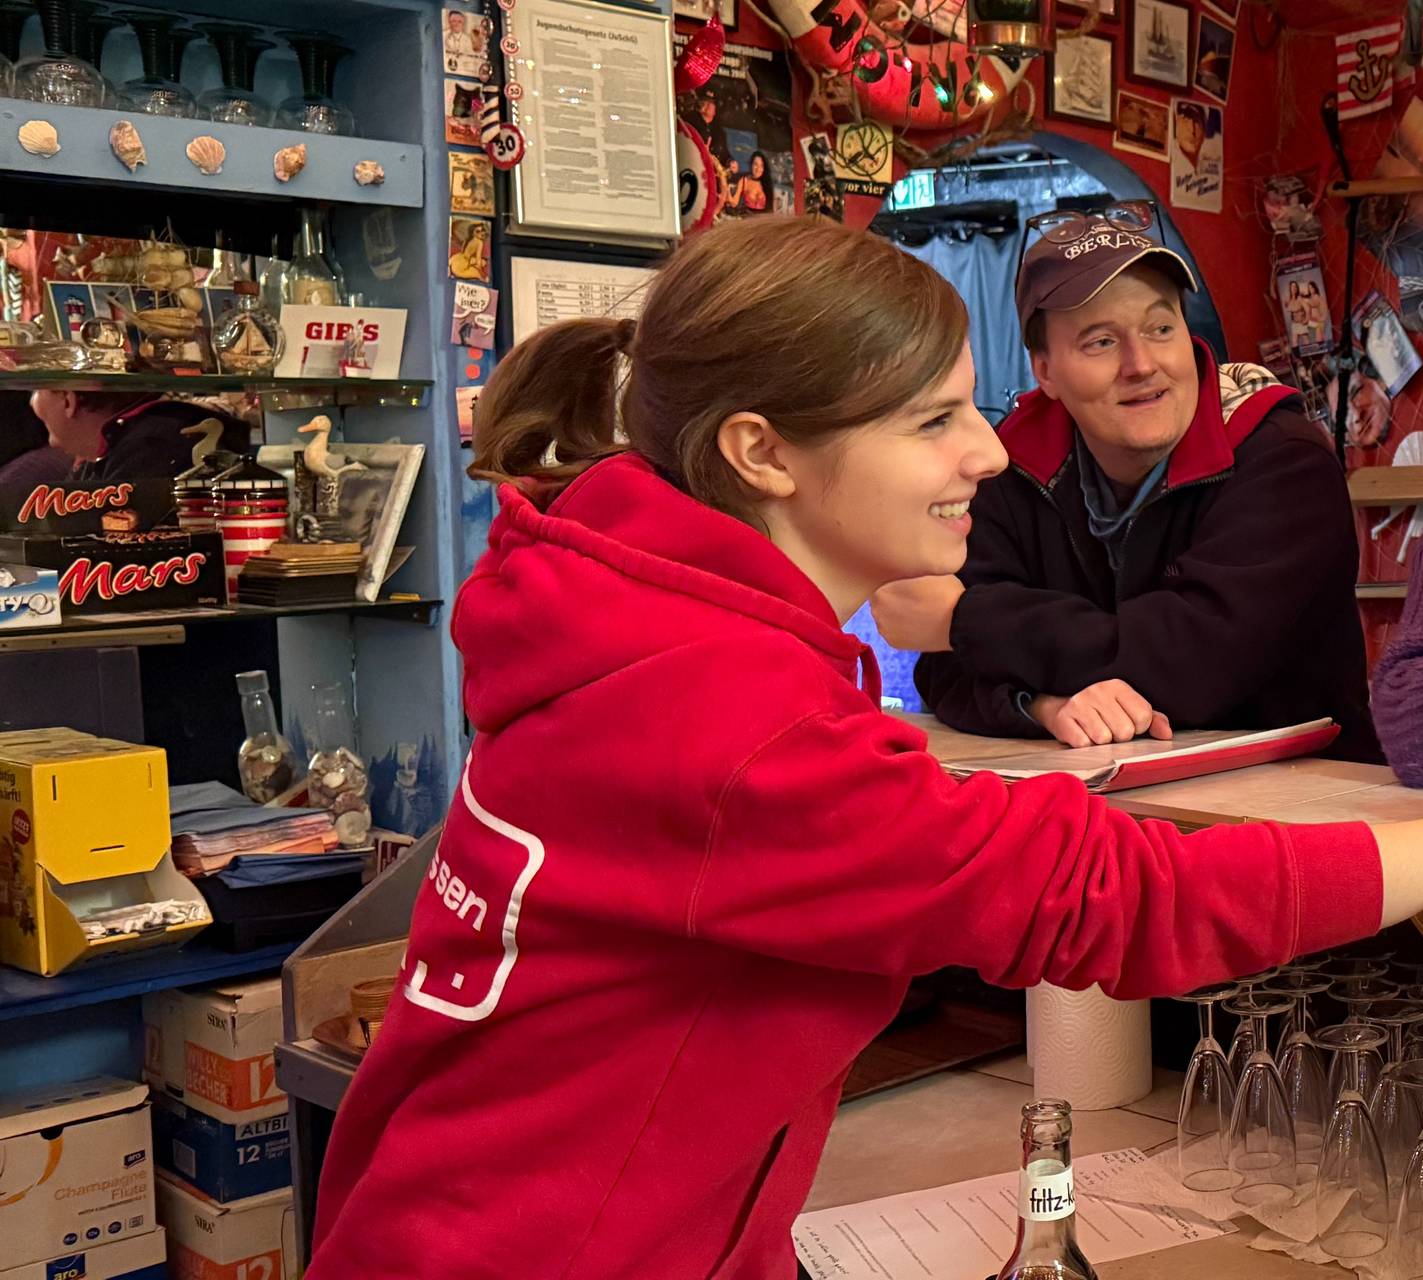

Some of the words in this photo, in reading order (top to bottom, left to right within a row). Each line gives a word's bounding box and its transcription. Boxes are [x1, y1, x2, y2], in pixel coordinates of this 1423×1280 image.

[495, 134, 516, 157] 30
[862, 182, 885, 196] vier
[18, 483, 134, 524] Mars
[59, 553, 206, 605] Mars
[237, 1144, 260, 1165] 12
[54, 1169, 147, 1201] Champagne
[111, 1184, 146, 1201] Flute
[1030, 1182, 1076, 1213] fritz-k
[53, 1268, 78, 1280] aro
